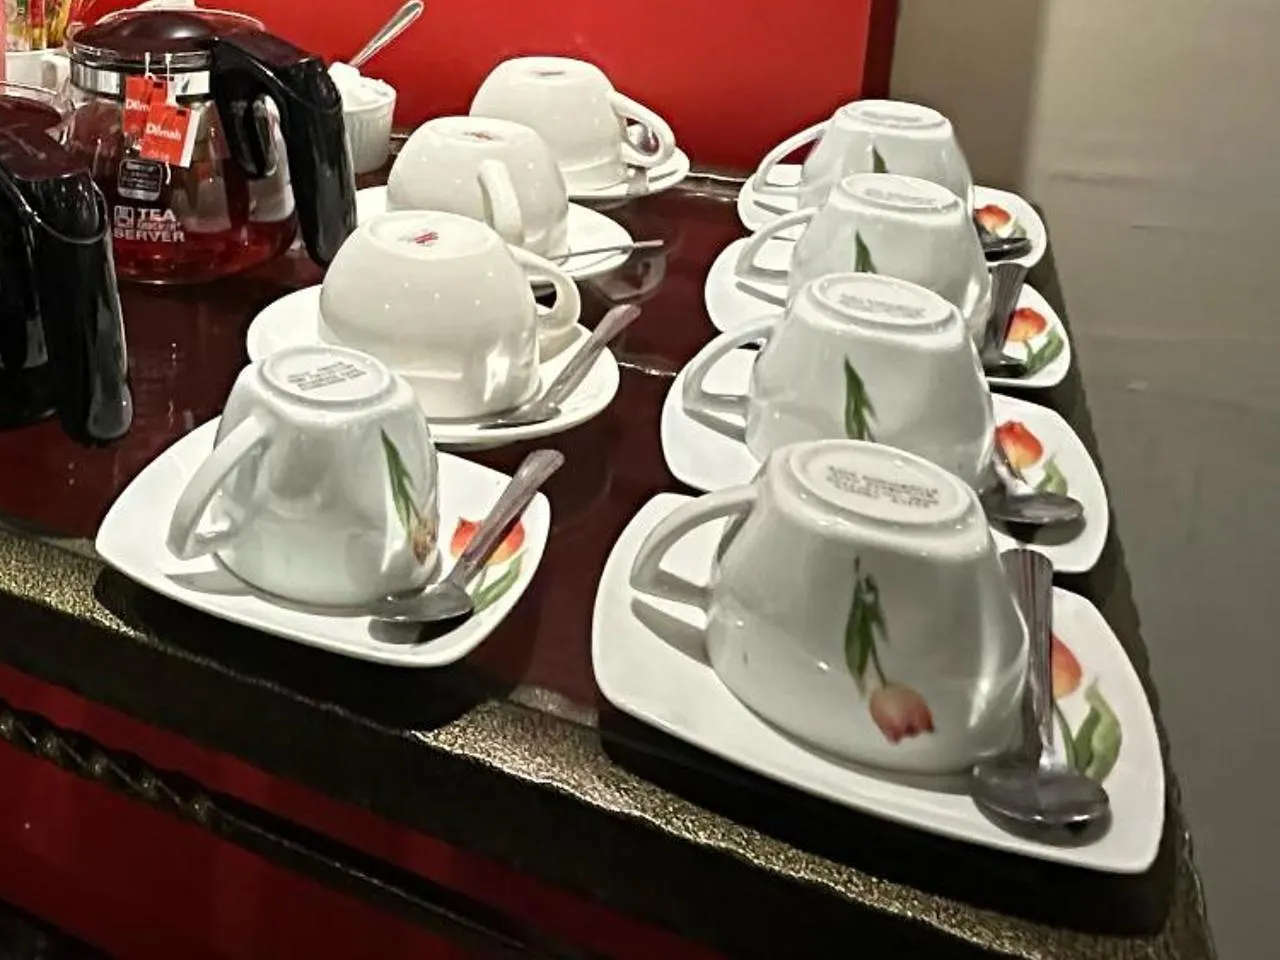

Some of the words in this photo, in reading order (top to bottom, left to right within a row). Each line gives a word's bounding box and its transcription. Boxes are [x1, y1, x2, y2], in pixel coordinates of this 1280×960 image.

[125, 98, 151, 113] Dilm
[145, 122, 182, 141] Dilmah
[137, 207, 176, 222] TEA
[113, 227, 185, 243] SERVER
